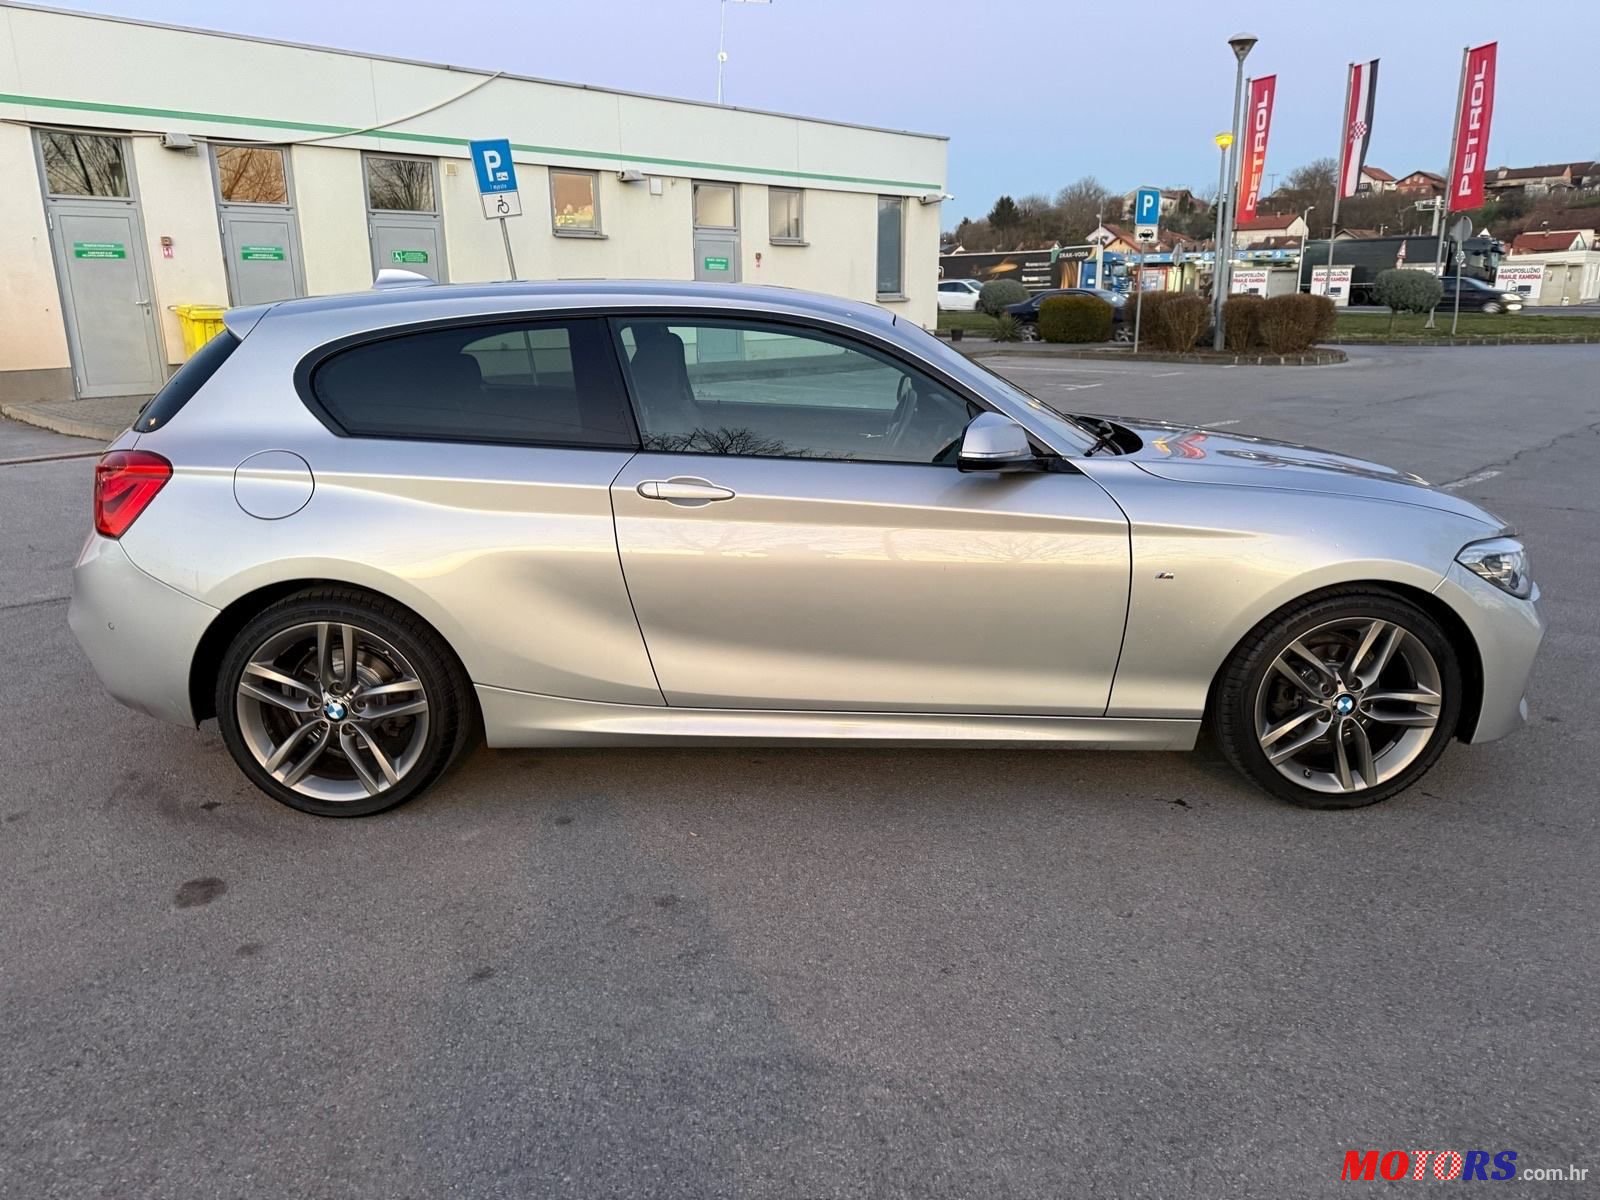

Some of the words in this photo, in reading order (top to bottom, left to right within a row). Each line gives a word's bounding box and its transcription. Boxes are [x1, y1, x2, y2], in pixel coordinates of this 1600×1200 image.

[483, 150, 501, 182] P
[1245, 90, 1268, 211] PETROL
[1458, 60, 1487, 196] PETROL
[1142, 194, 1154, 217] P
